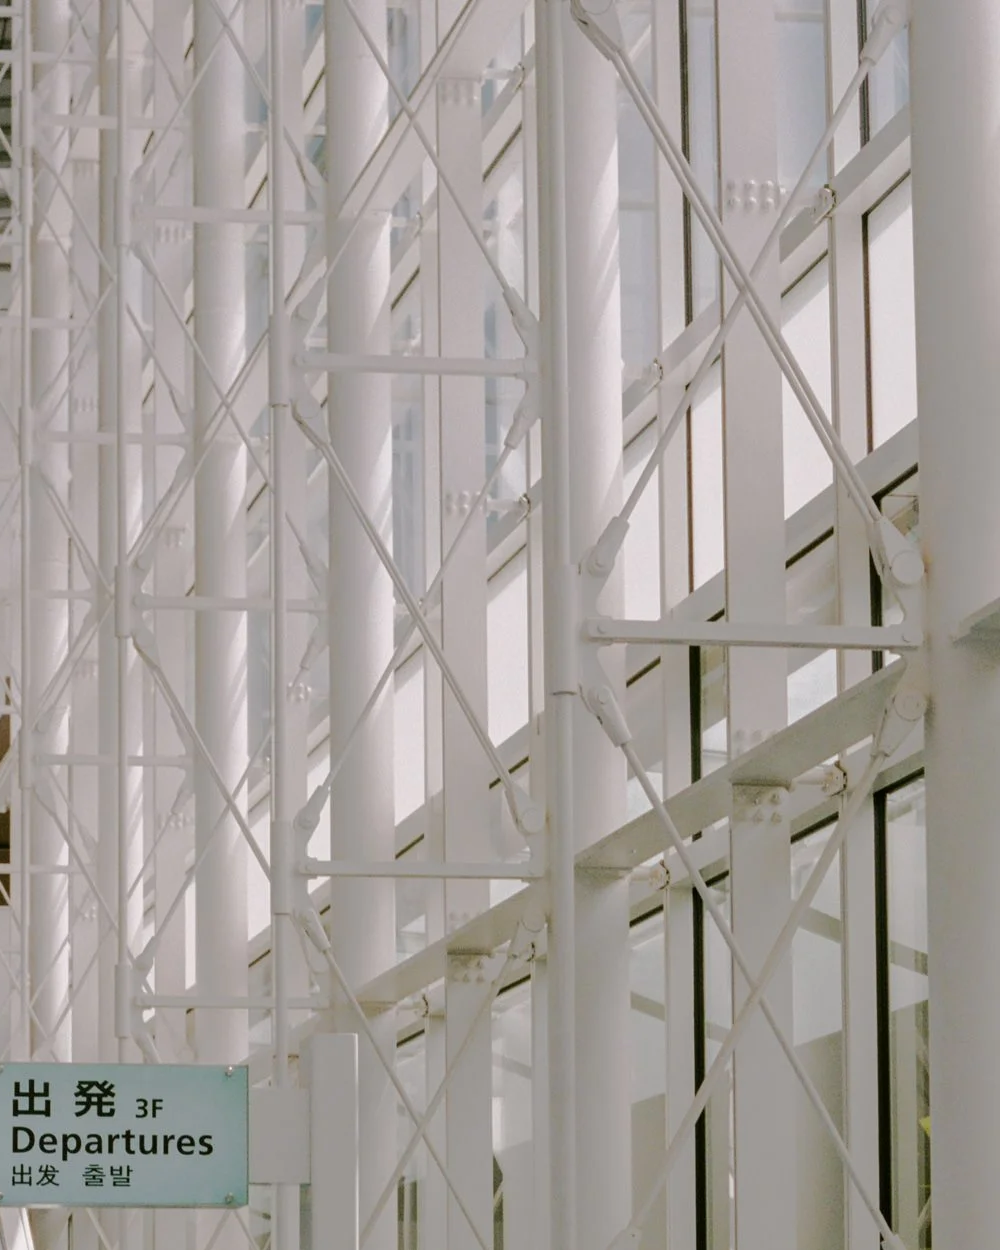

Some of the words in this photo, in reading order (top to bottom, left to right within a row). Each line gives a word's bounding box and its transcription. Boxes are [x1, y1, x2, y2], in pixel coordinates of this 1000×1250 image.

[12, 1079, 116, 1118] 出発
[135, 1097, 164, 1119] 3F
[11, 1126, 214, 1162] Departures
[11, 1165, 60, 1187] 出发
[82, 1163, 134, 1188] 출발
